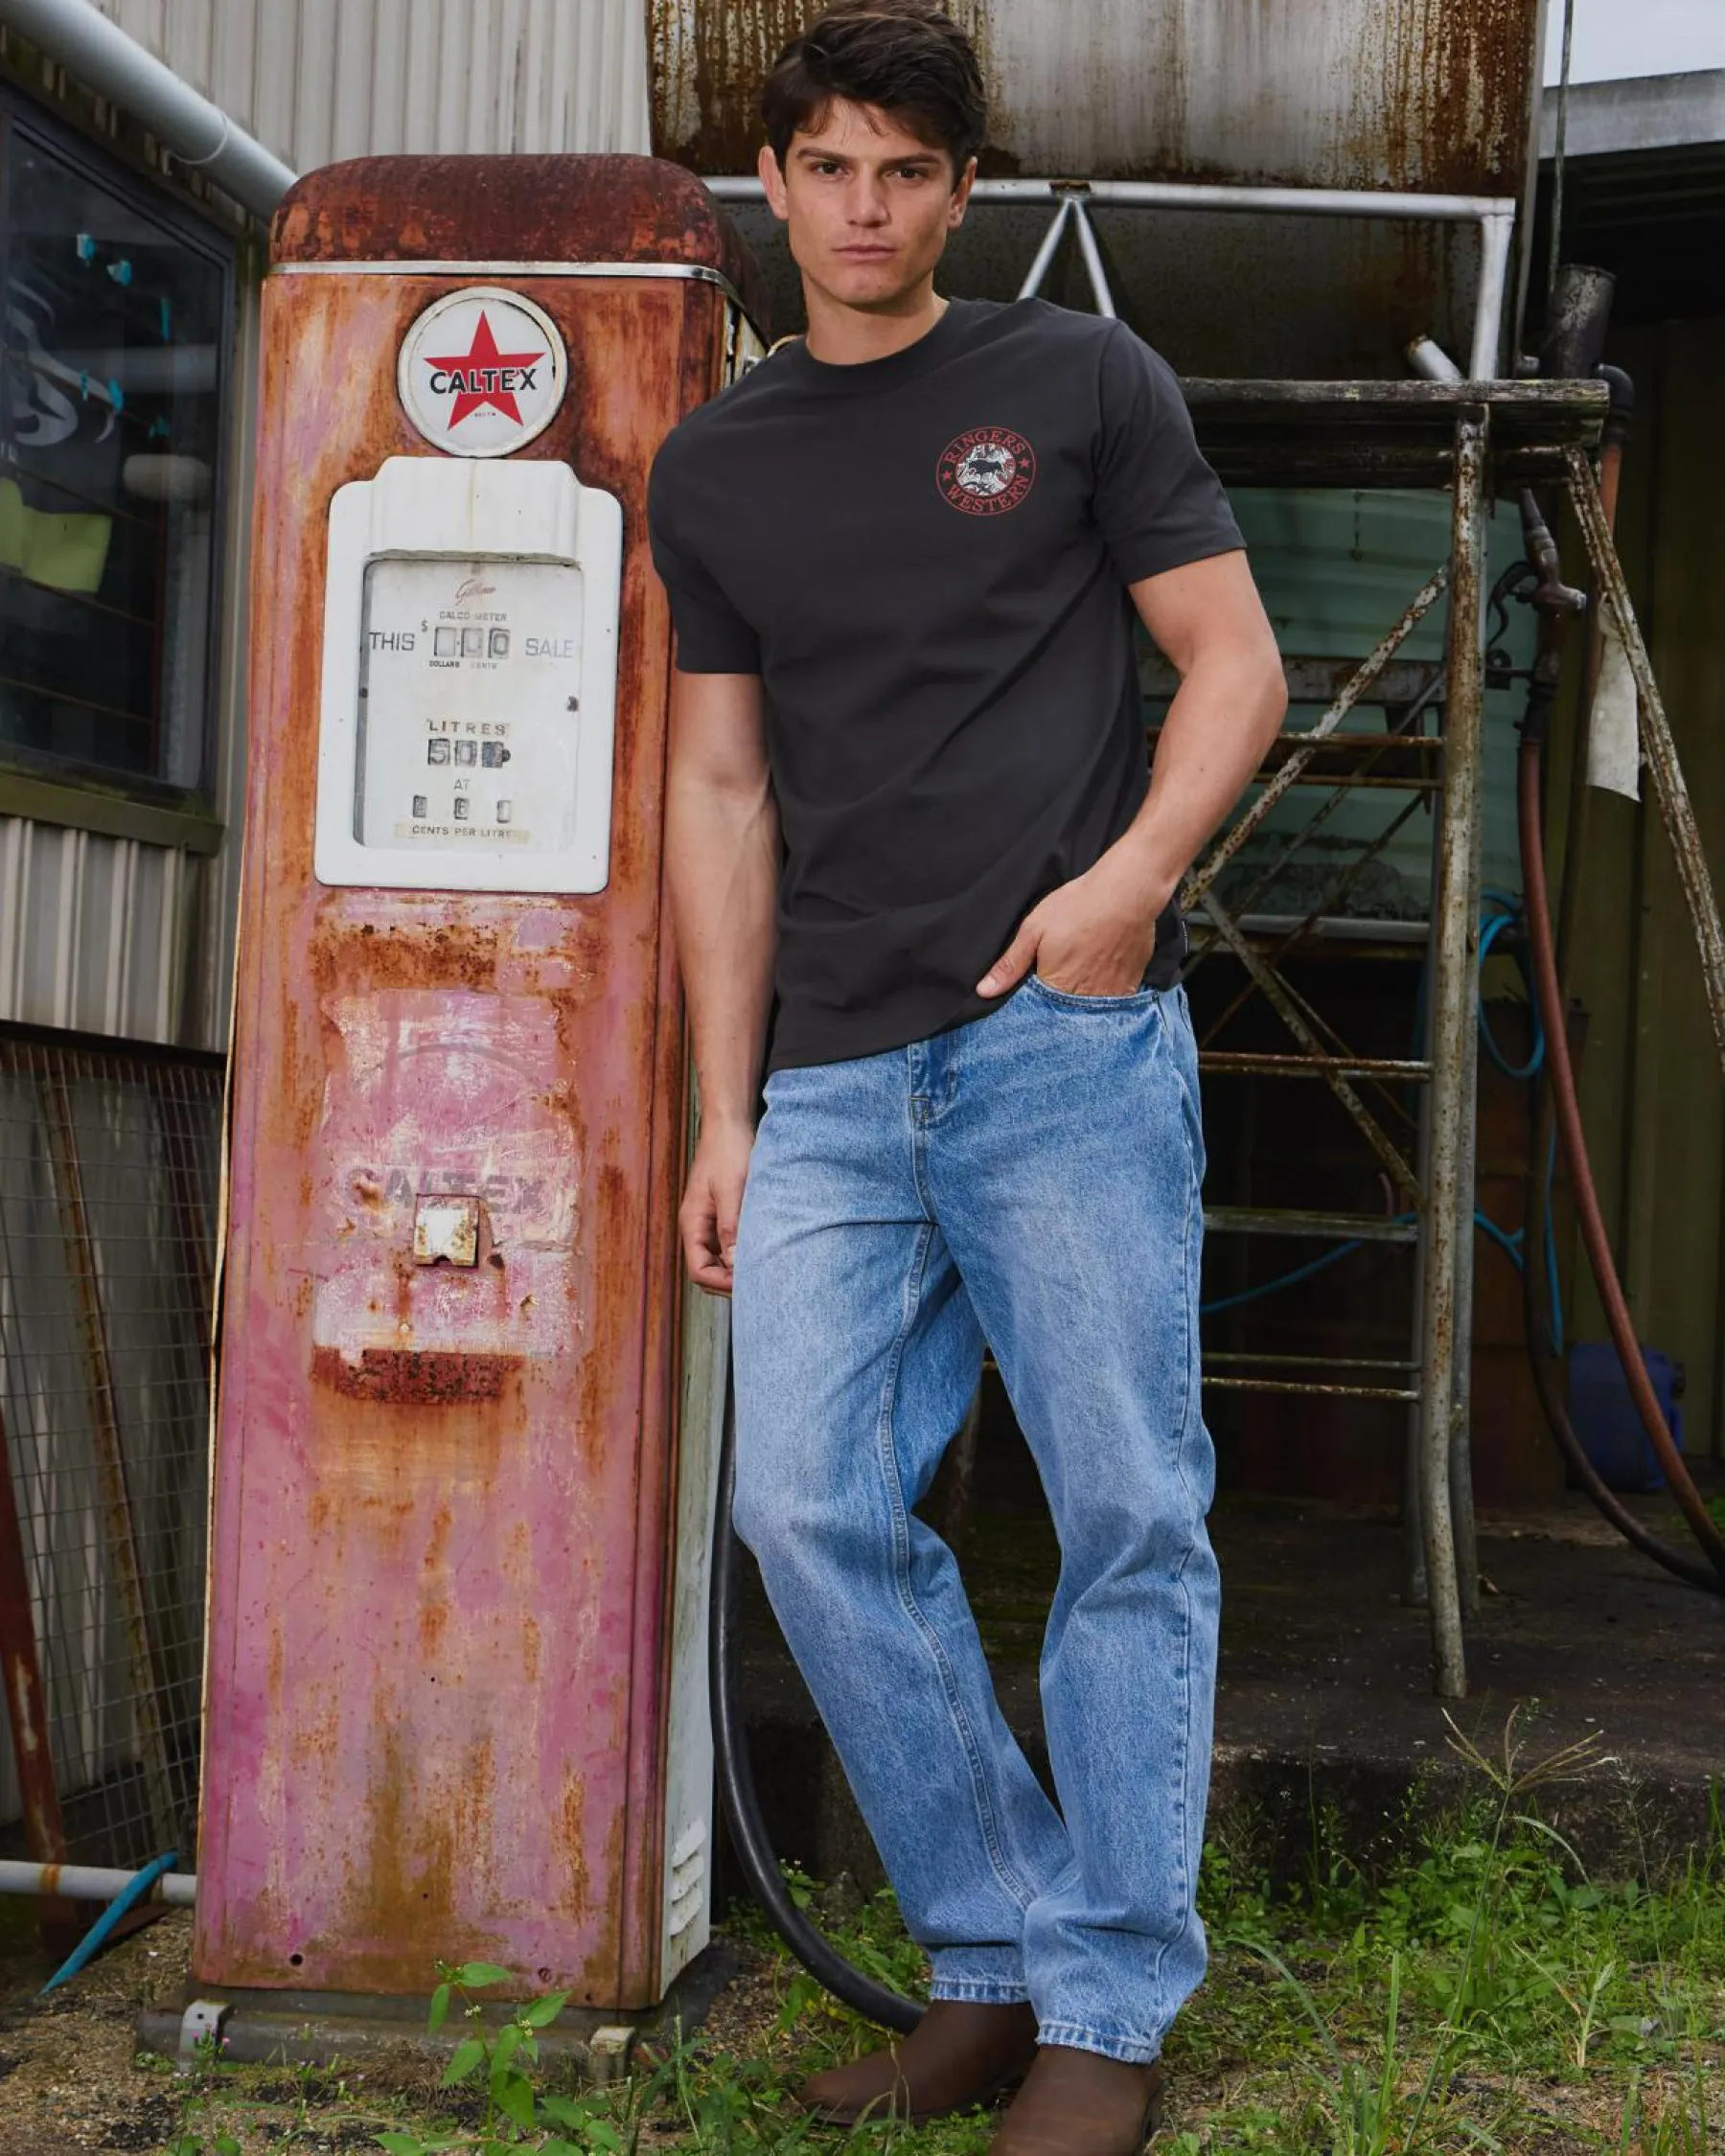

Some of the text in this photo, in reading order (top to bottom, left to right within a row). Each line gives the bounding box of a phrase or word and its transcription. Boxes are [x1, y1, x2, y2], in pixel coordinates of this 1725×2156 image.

[429, 368, 538, 395] CALTEX
[943, 429, 1027, 464] RINGERS
[947, 474, 1030, 512] WESTERN
[368, 631, 415, 651] THIS
[525, 636, 575, 659] SALE
[428, 720, 506, 736] LITRES
[453, 778, 471, 791] AT
[412, 824, 449, 836] CENTS
[454, 827, 476, 837] PER
